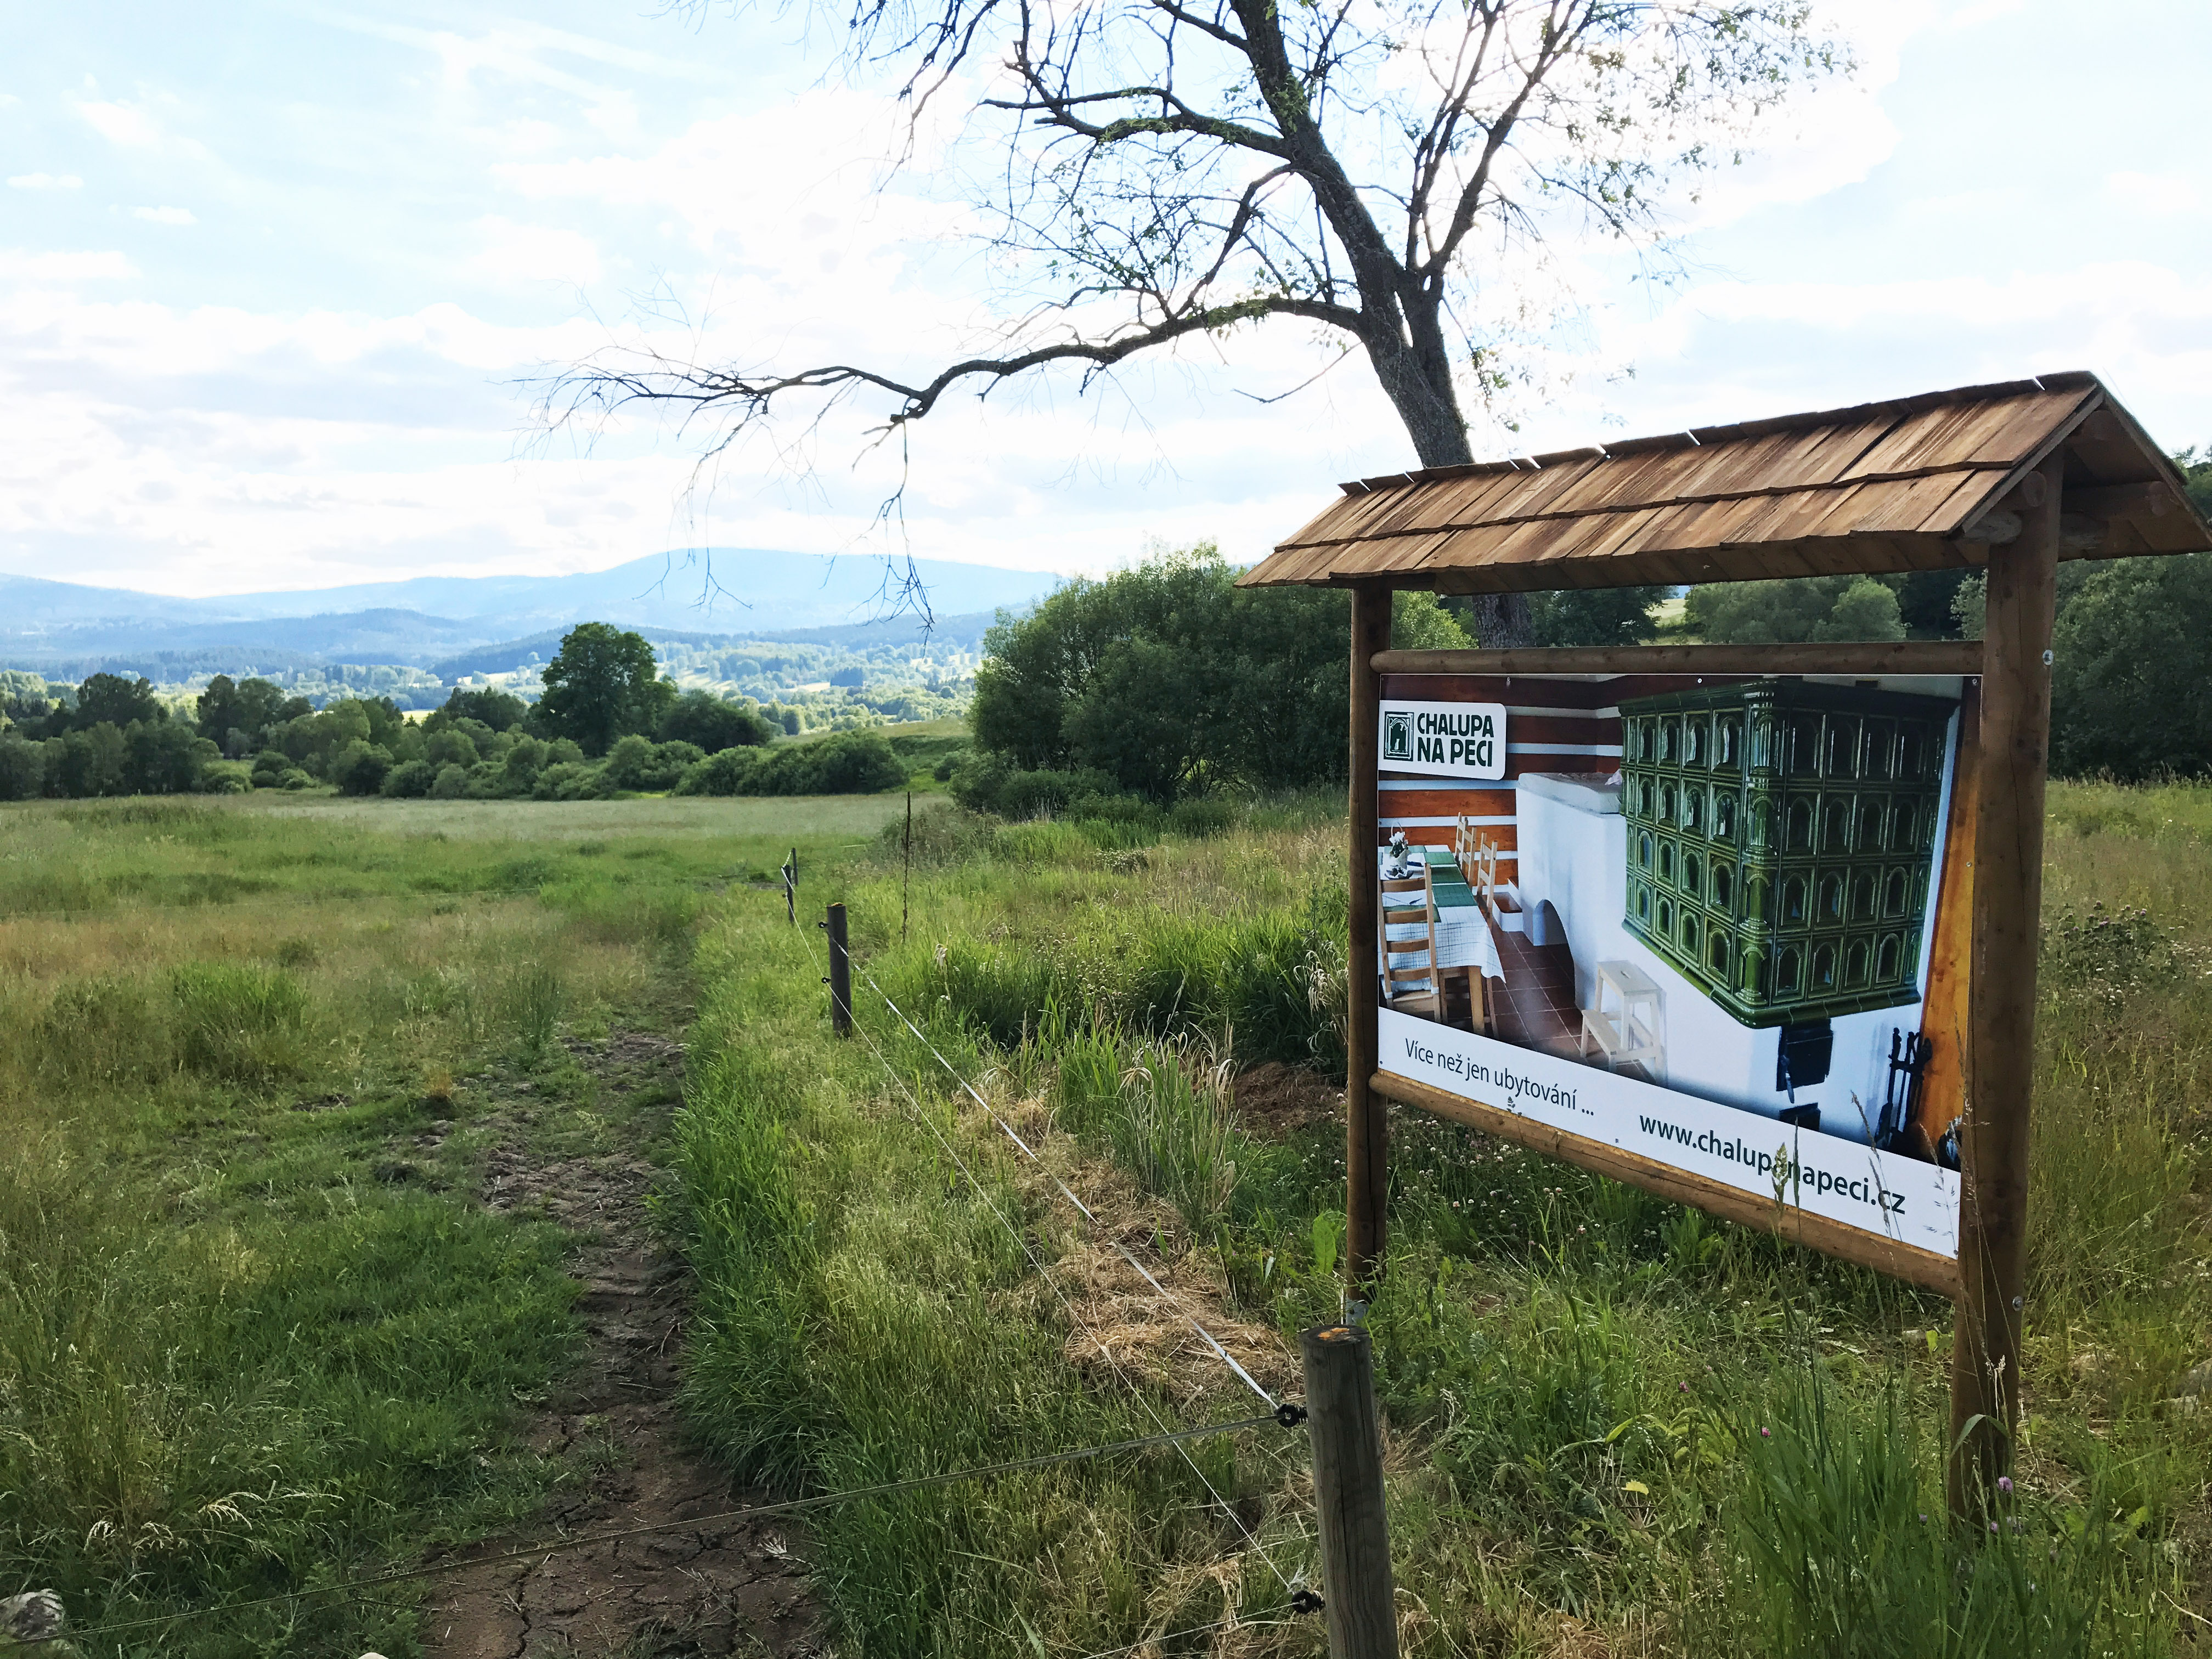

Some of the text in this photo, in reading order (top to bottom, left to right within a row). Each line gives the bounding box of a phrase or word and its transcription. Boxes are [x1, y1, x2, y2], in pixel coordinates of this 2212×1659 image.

[1417, 713, 1494, 737] CHALUPA
[1417, 737, 1493, 767] NA PECI
[1406, 1038, 1433, 1064] Více
[1438, 1053, 1463, 1074] než
[1465, 1058, 1489, 1082] jen
[1494, 1068, 1578, 1109] ubytování
